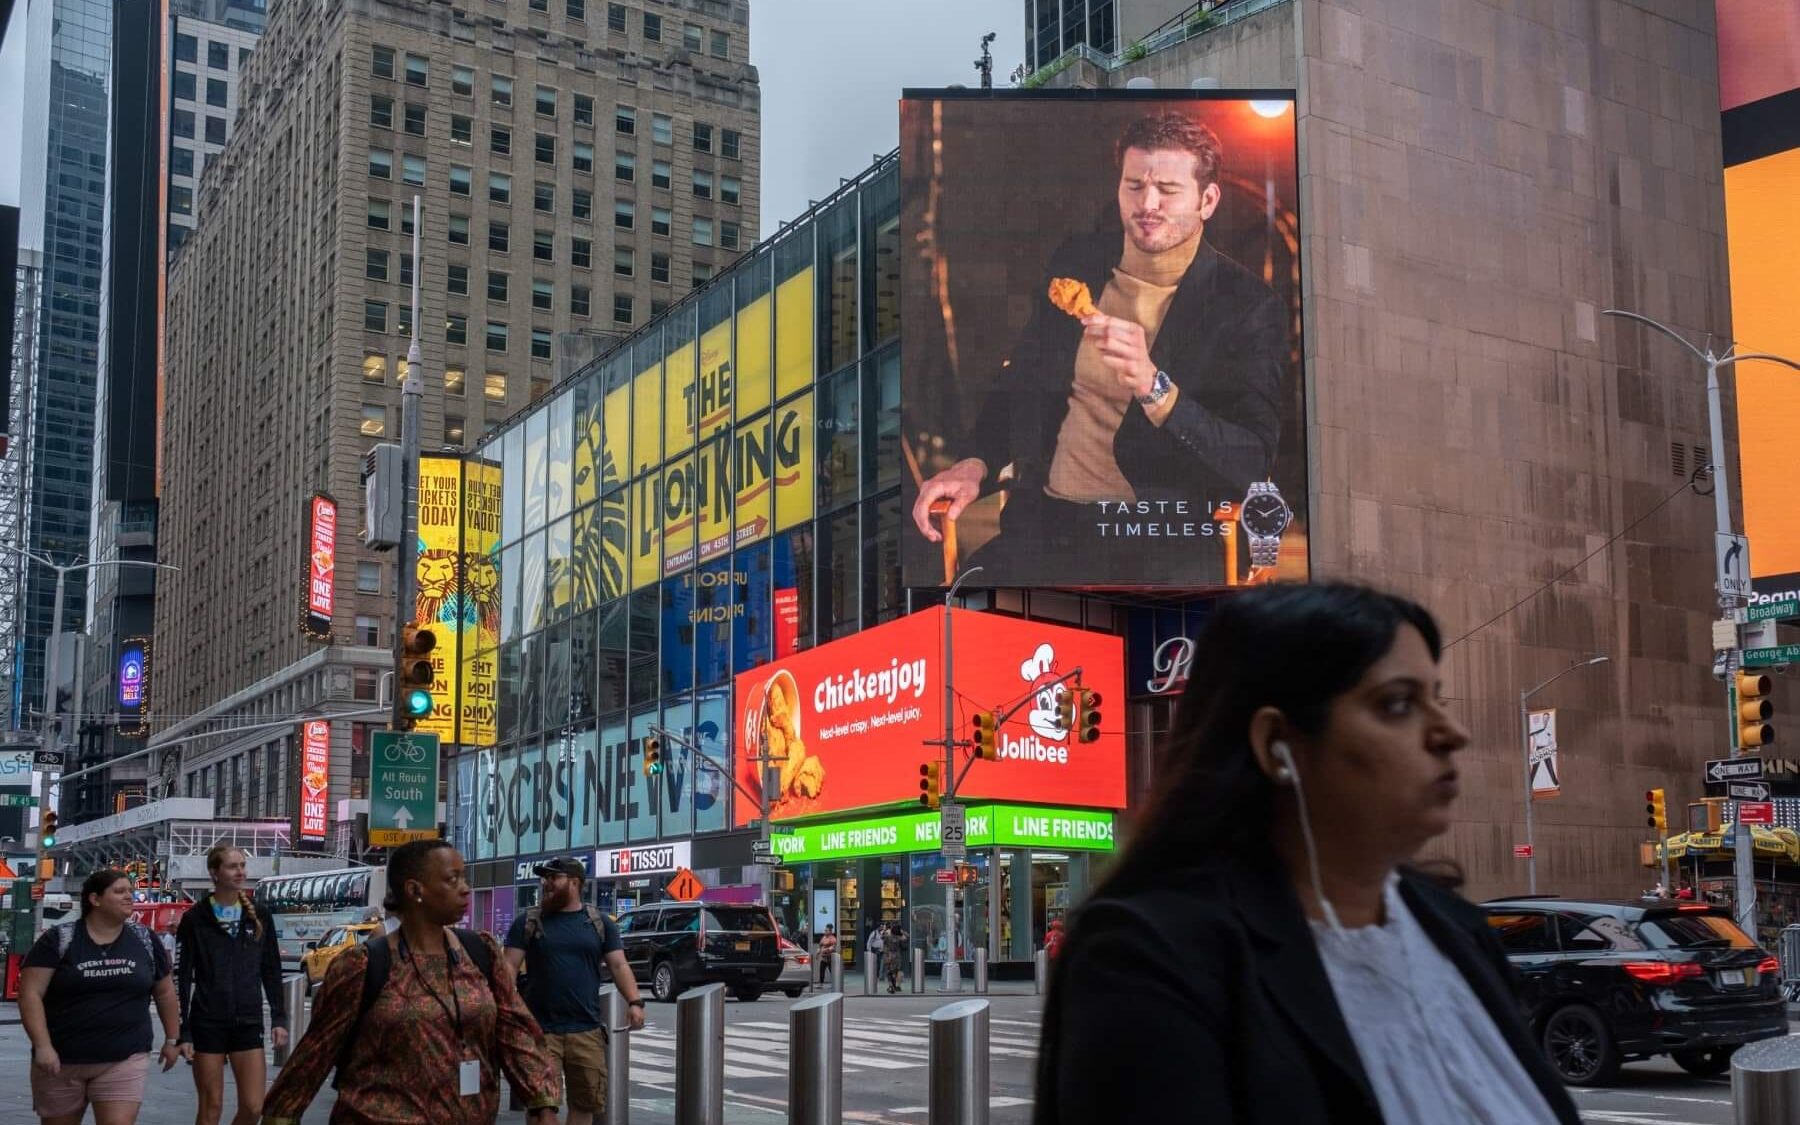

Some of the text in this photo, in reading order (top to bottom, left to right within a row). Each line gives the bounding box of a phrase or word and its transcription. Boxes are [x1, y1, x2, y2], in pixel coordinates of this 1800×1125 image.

[683, 361, 731, 427] THE
[420, 476, 457, 491] ET YOUR
[639, 409, 801, 558] LION KING
[420, 489, 457, 507] ICKETS
[418, 505, 457, 527] ODAY
[1097, 501, 1234, 514] TASTE IS
[1097, 523, 1234, 537] TIMELESS
[666, 522, 756, 569] ENTRANCE ON 45TH STREET
[313, 579, 332, 599] ONE
[1723, 578, 1747, 590] ONLY
[312, 594, 331, 612] LOVE
[1749, 602, 1795, 619] Broadway
[1745, 646, 1800, 660] George Ab
[814, 657, 926, 713] Chickenjoy
[820, 706, 922, 740] Next-level crispy. Next-level juicy.
[996, 733, 1068, 764] Jollibee
[382, 771, 427, 784] Alt Route
[507, 758, 575, 837] CBS
[582, 719, 720, 827] NEWS
[1714, 764, 1755, 775] ONE WAY
[385, 786, 423, 801] South
[1734, 787, 1764, 797] ONE WAY
[304, 801, 325, 818] ONE
[303, 816, 324, 831] LOVE
[1013, 815, 1050, 838] LINE
[777, 835, 806, 855] YORK
[820, 833, 847, 851] LINE
[848, 825, 897, 848] FRIENDS
[944, 826, 963, 841] 25
[77, 958, 136, 970] EVERY BODY IS
[83, 967, 133, 977] BEAUTIFUL
